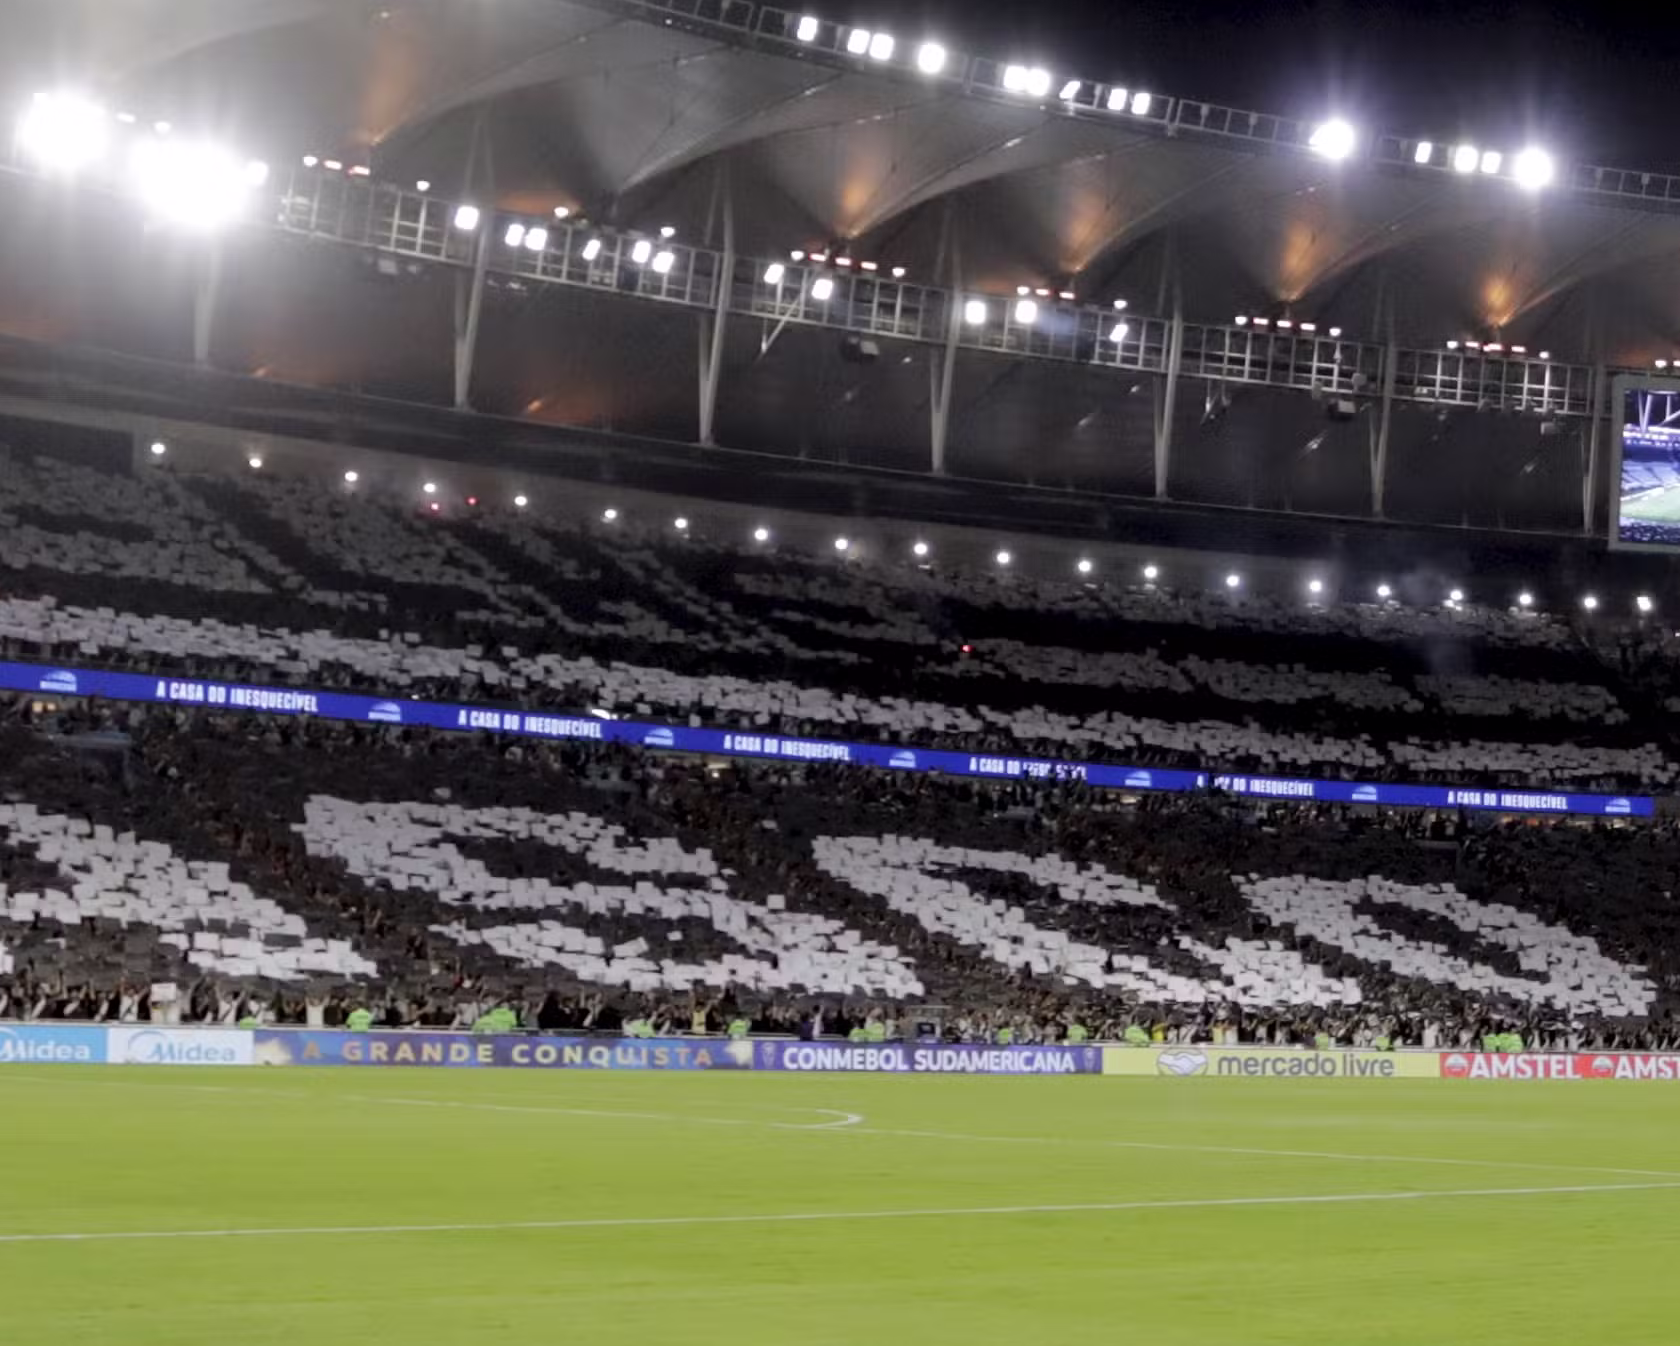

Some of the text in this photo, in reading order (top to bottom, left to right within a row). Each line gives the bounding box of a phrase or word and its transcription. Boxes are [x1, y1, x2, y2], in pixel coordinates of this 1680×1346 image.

[156, 681, 318, 712] A CASA DO INESQUECÍVEL
[458, 709, 602, 739] A CASA DO INESQUECÍVEL
[140, 1034, 236, 1062] Midea
[303, 1041, 711, 1066] A GRANDE CONQUISTA
[783, 1047, 1074, 1072] CONMEBOL SUDAMERICANA
[1218, 1054, 1394, 1077] mercado livre
[1469, 1055, 1581, 1078] AMSTEL
